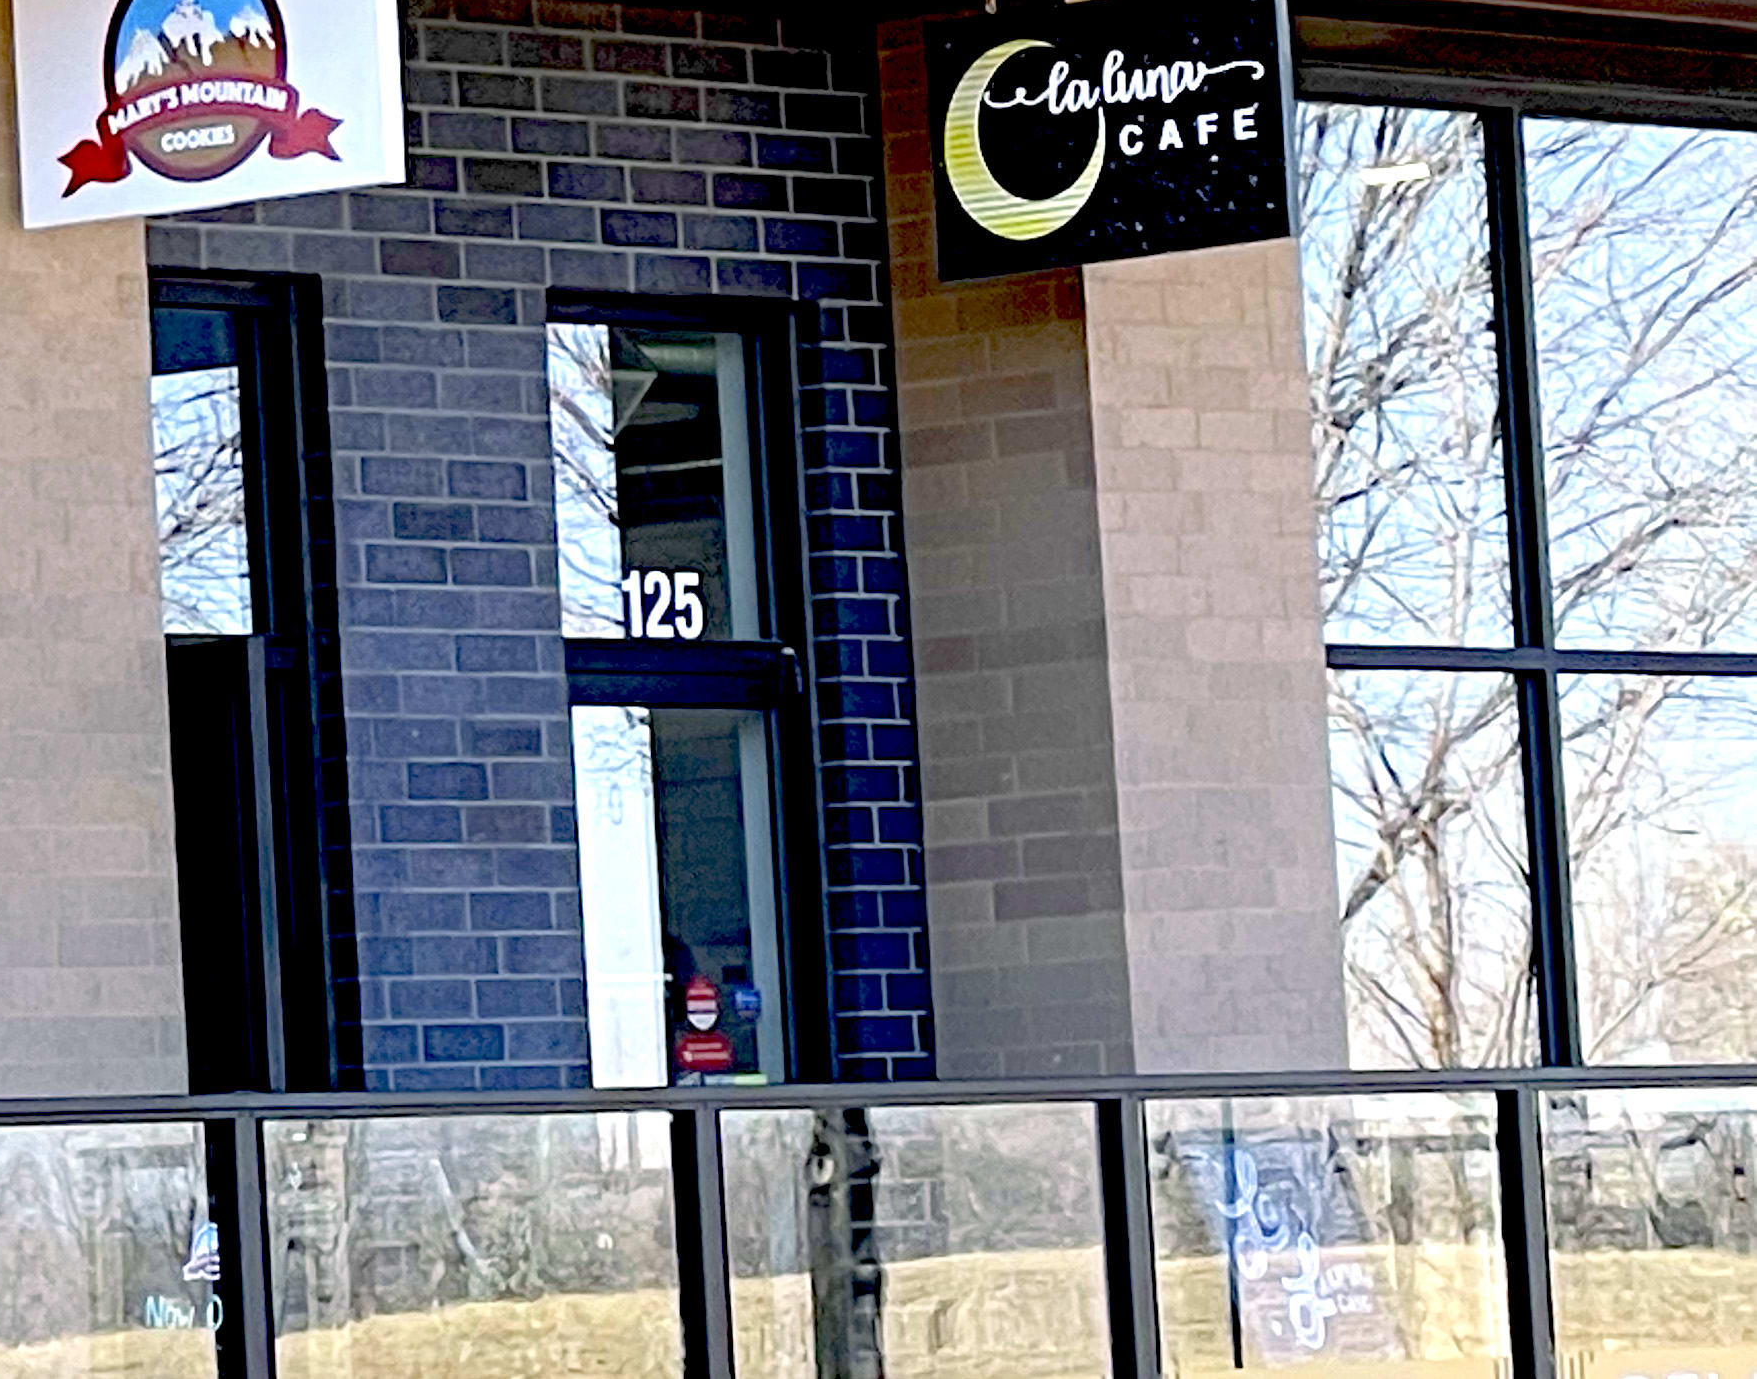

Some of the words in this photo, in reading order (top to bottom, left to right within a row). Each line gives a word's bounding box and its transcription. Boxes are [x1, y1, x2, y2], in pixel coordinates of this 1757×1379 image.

[1102, 49, 1265, 103] luna
[108, 86, 179, 135] MARY'S
[180, 80, 289, 112] MOUNTAIN
[160, 124, 235, 153] COOKIES
[621, 569, 704, 640] 125
